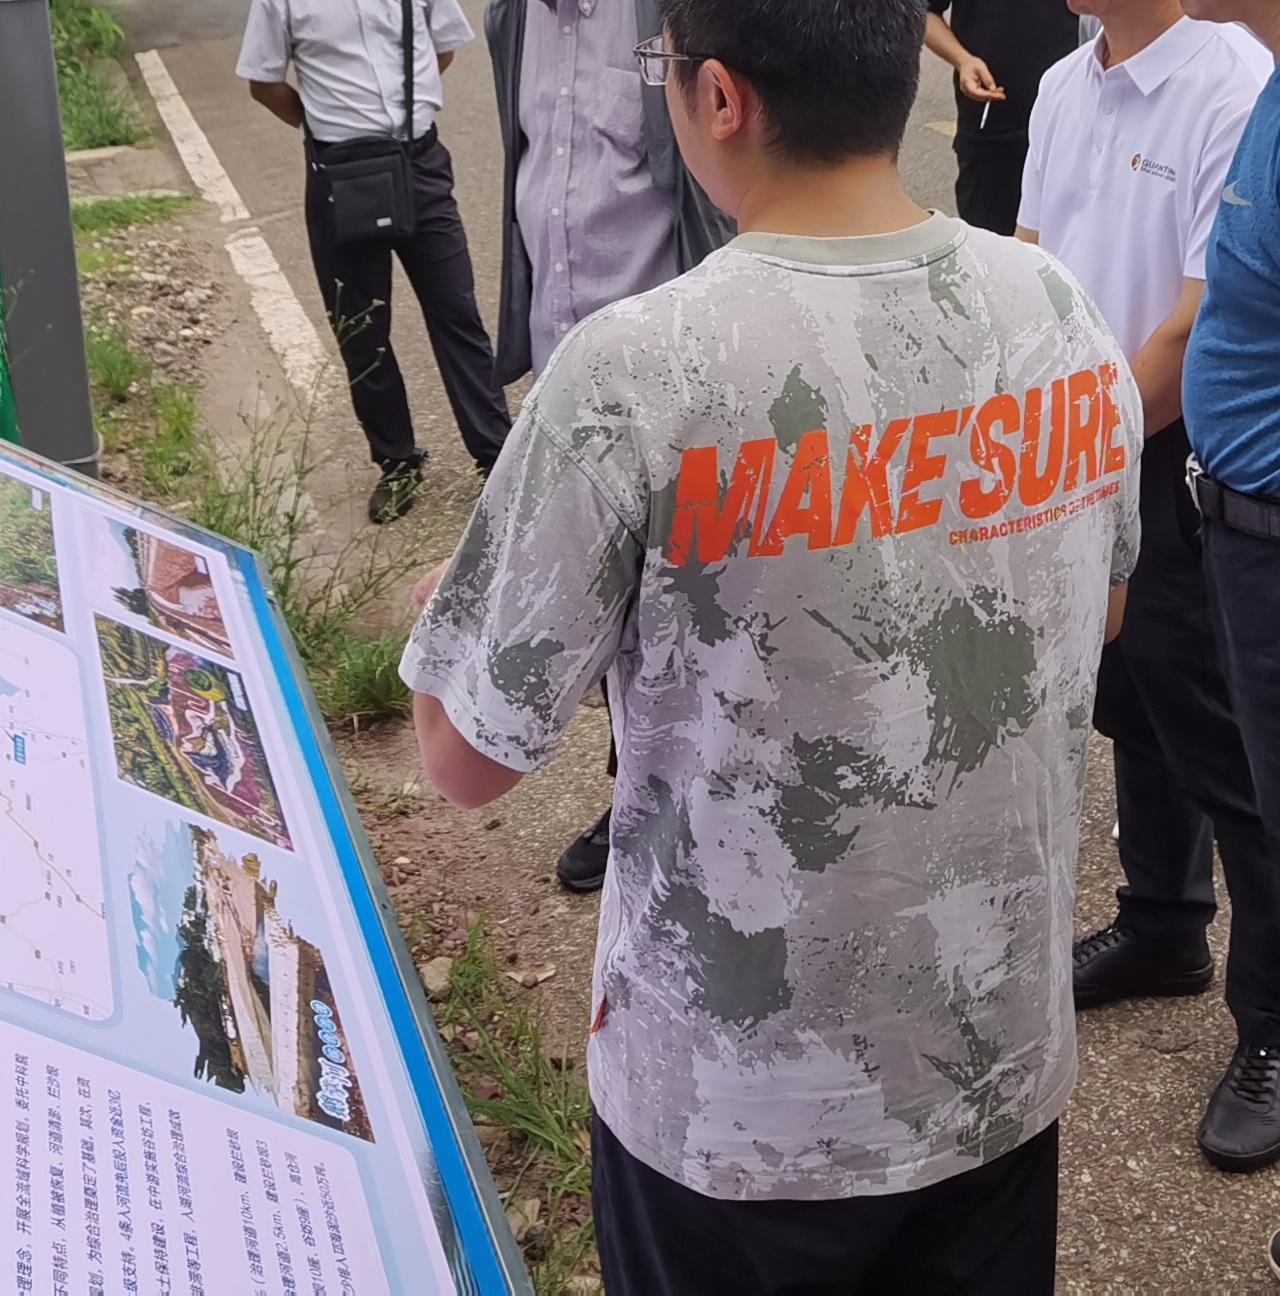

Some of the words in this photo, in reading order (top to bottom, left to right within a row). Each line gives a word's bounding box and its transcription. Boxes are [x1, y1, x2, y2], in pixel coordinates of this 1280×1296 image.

[948, 505, 1067, 546] CHARACTERISTICS
[14, 1053, 34, 1296] 理理念，开展全流域科学规划。委托中科院
[107, 1089, 140, 1296] 级支持。4条入河流先后投入资金近3亿
